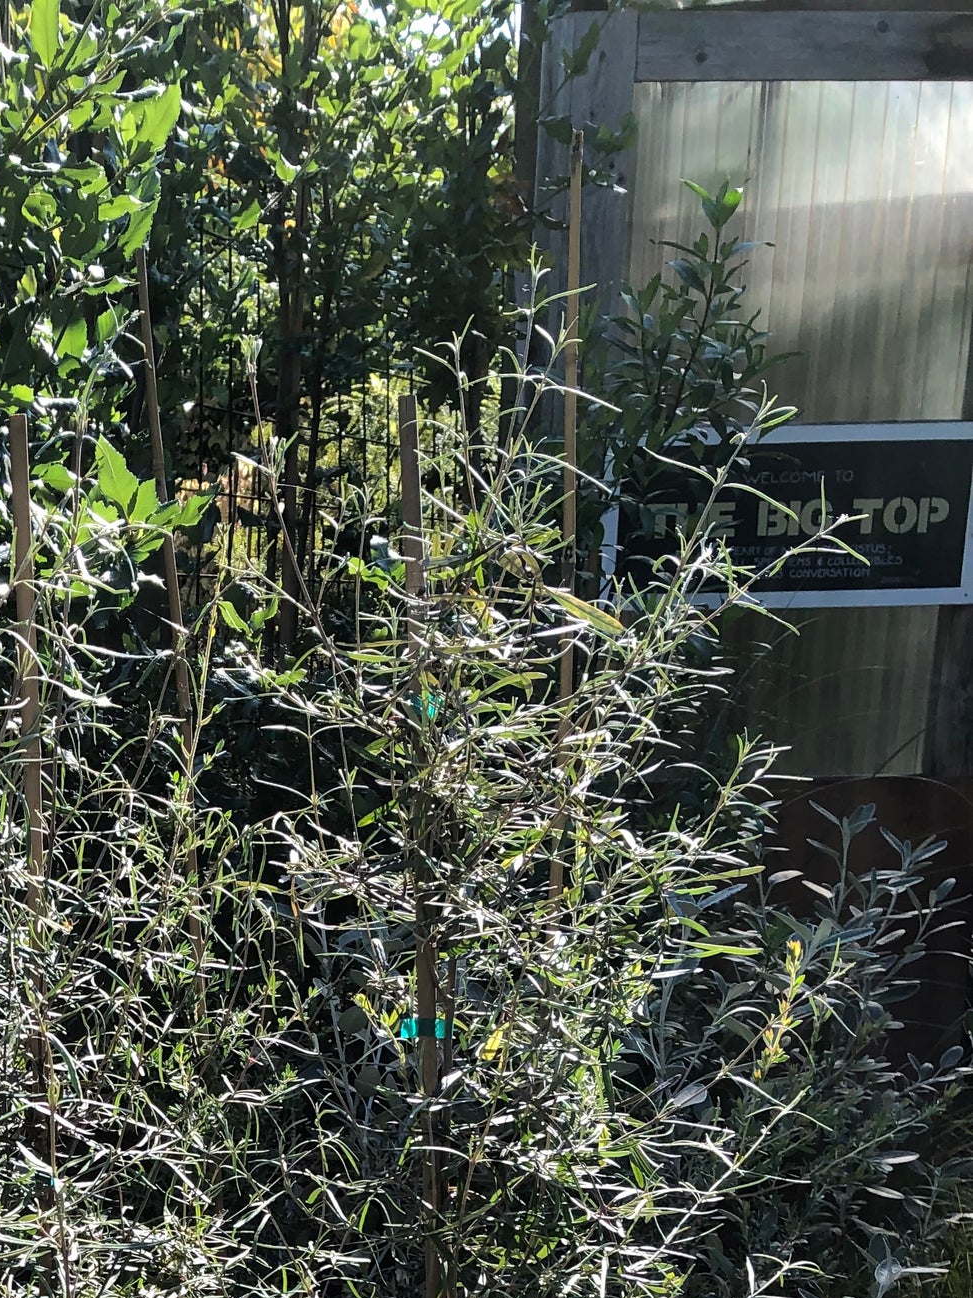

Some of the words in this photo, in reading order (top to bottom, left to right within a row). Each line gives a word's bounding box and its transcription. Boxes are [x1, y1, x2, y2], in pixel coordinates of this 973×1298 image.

[742, 471, 826, 485] WELCOME
[835, 470, 855, 482] TO
[756, 498, 834, 537] BIG
[852, 496, 951, 535] TOP
[788, 567, 871, 579] CONVERSATION
